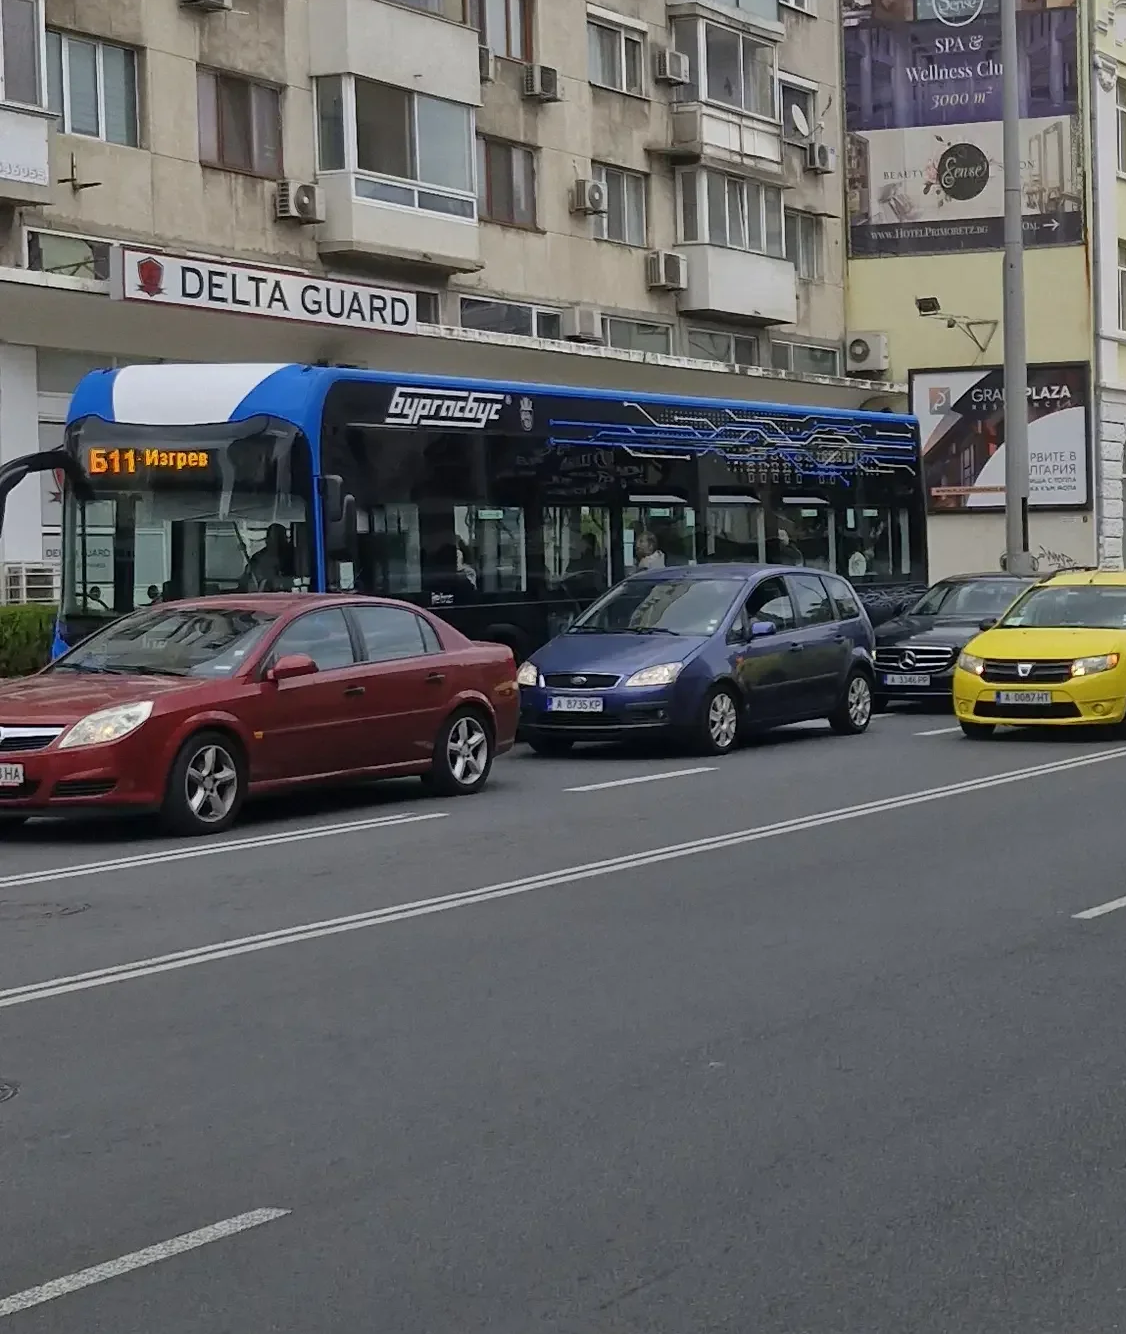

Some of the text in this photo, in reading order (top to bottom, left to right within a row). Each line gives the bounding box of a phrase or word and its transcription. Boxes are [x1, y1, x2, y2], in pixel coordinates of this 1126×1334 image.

[935, 35, 983, 53] SPA &
[905, 60, 1004, 83] Wellness Clu
[930, 94, 969, 110] 3000
[883, 169, 924, 180] BEAUTY
[943, 157, 987, 189] Sense
[180, 266, 409, 327] DELTA GUARD
[971, 388, 1005, 403] GRA
[89, 448, 209, 473] Б11 Изгрев
[1030, 451, 1077, 462] РВИТЕ В
[1028, 464, 1077, 475] ЛГАРИЯ
